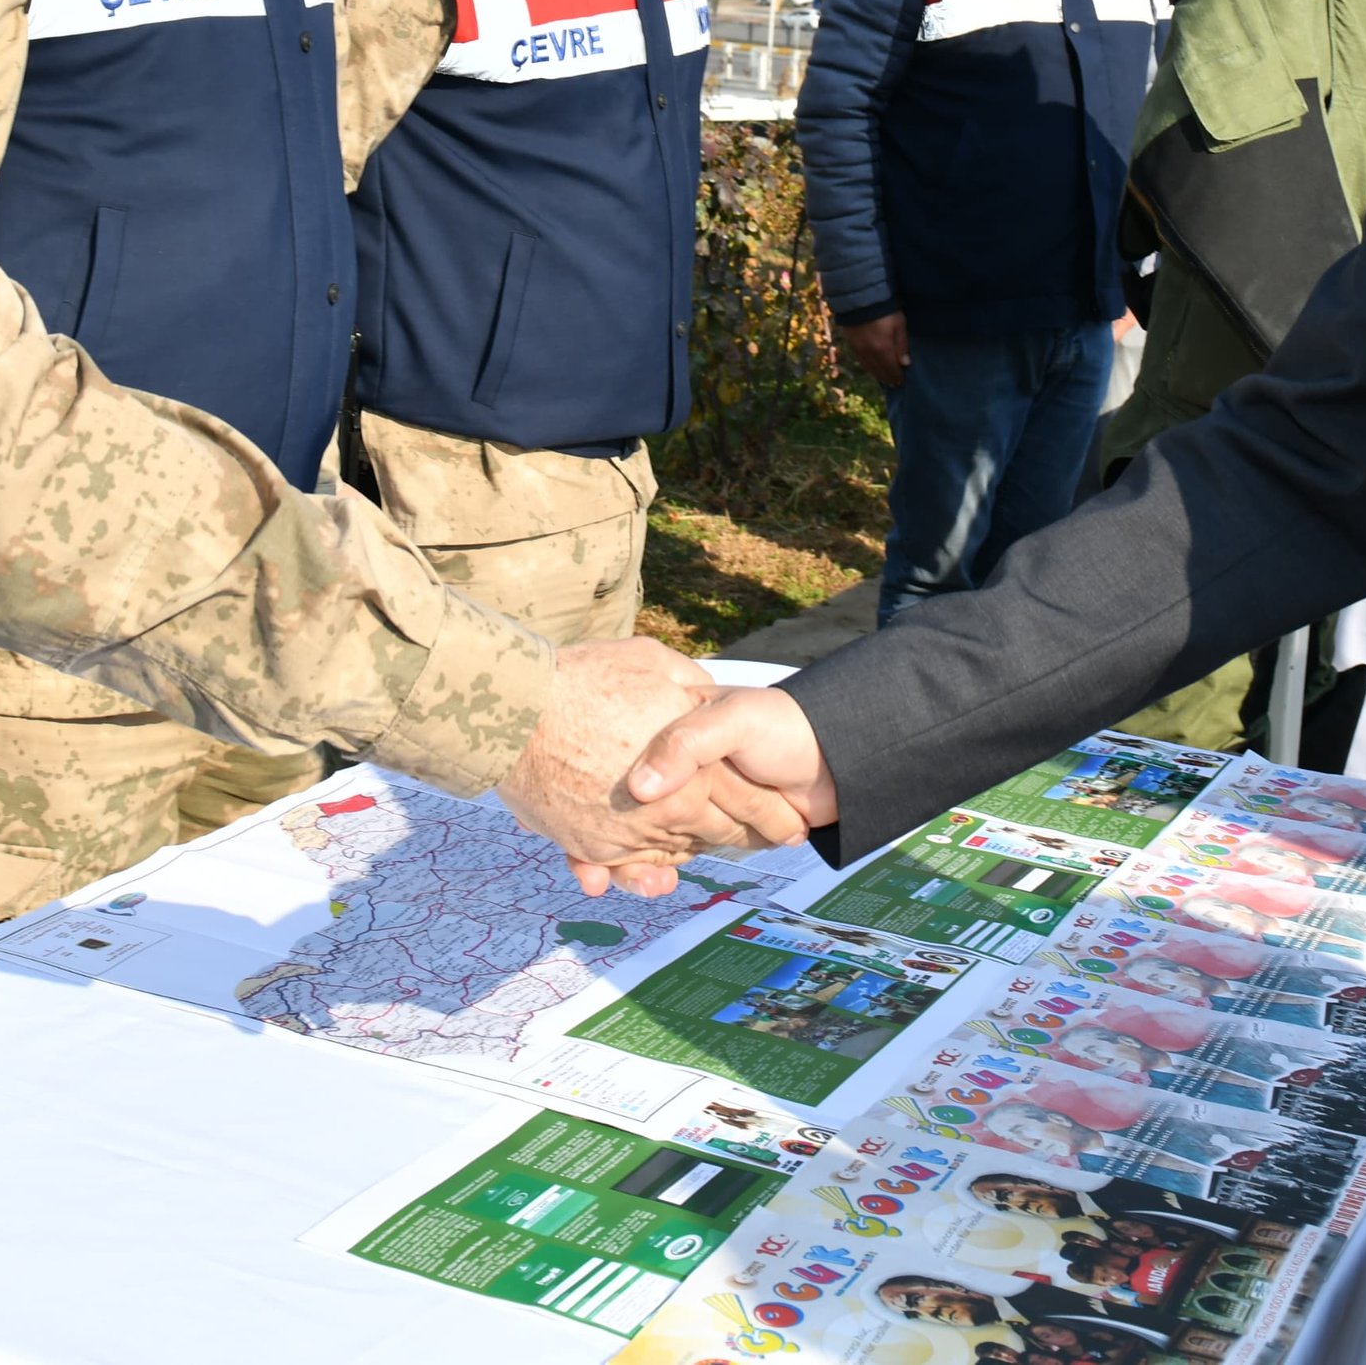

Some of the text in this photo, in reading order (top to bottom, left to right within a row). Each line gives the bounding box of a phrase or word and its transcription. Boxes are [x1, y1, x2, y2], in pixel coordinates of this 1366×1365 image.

[511, 24, 605, 72] ÇEVRE
[843, 1146, 949, 1238] ÇOCUK
[737, 1245, 857, 1354] ÇOCUK
